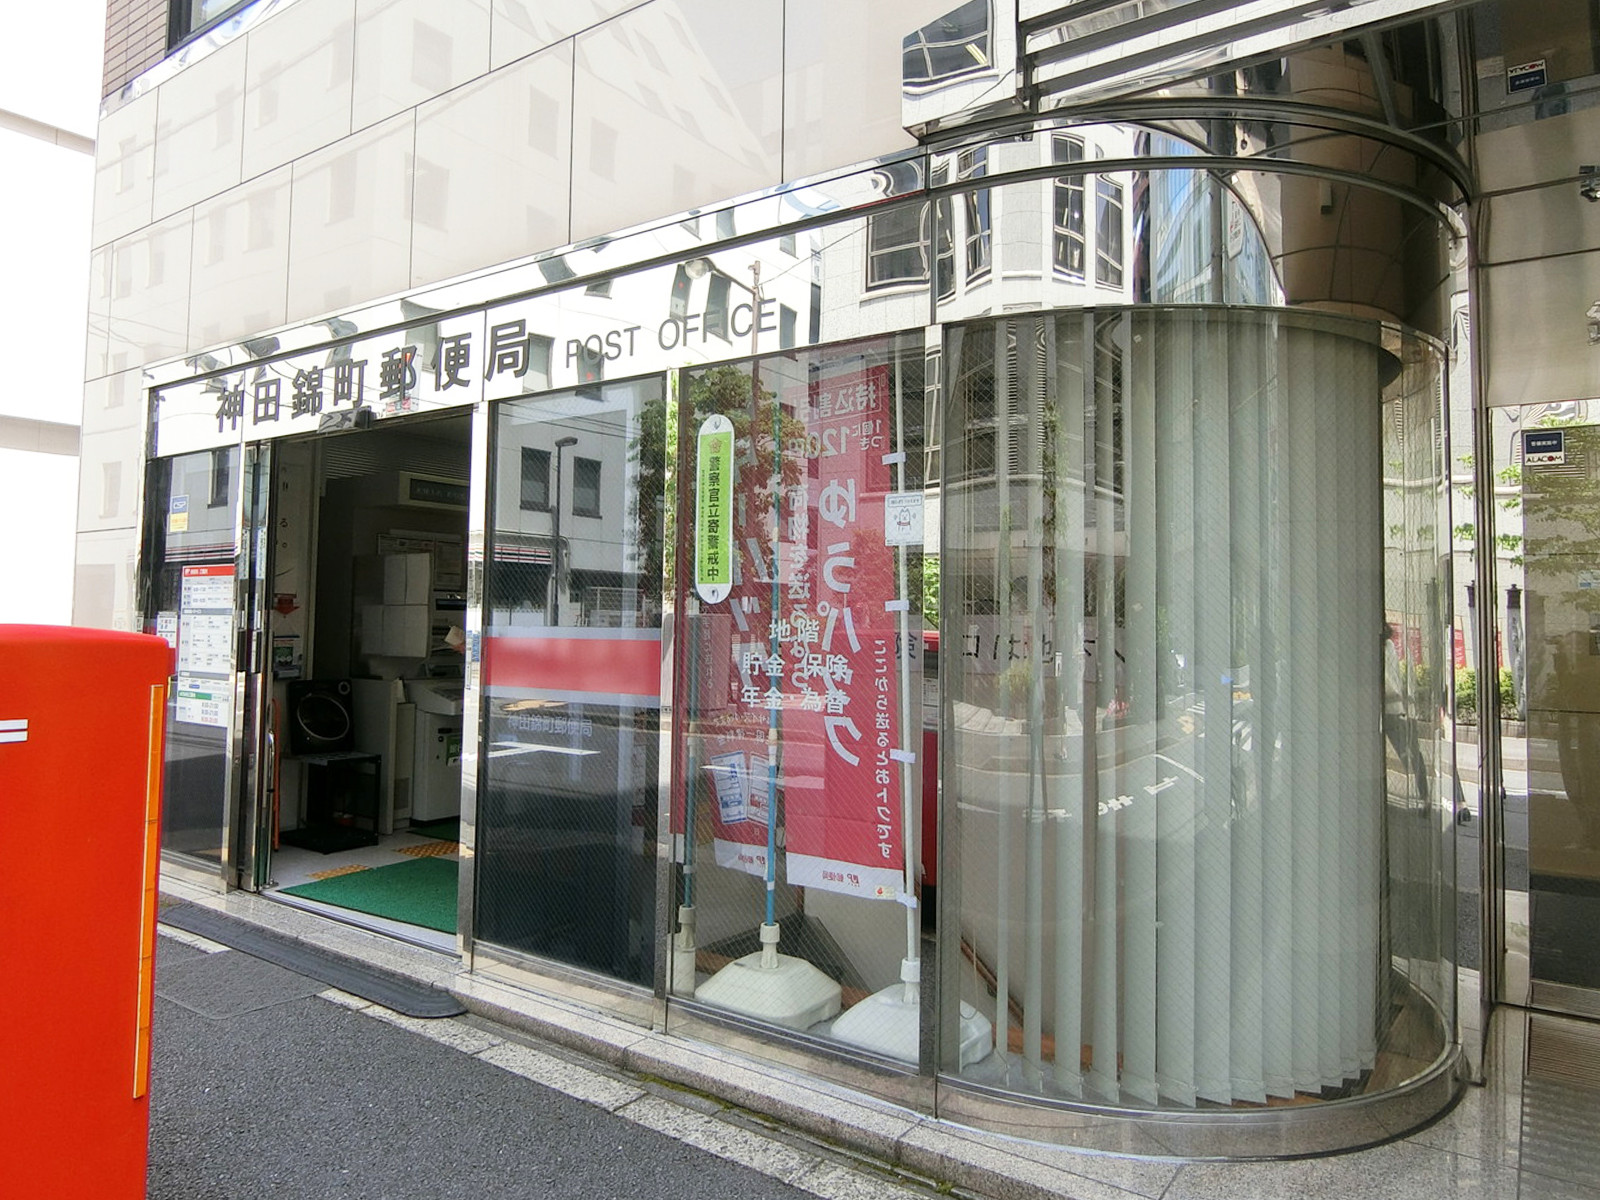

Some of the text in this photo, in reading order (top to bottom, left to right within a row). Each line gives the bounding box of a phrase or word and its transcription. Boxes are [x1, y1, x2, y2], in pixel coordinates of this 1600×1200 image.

[566, 297, 777, 369] POST OFFICE
[216, 318, 528, 433] 神田錦町郵便局
[706, 456, 720, 582] 警察官立寄警戒中
[769, 618, 820, 645] 地階
[508, 714, 593, 738] 神田錦町郵便局
